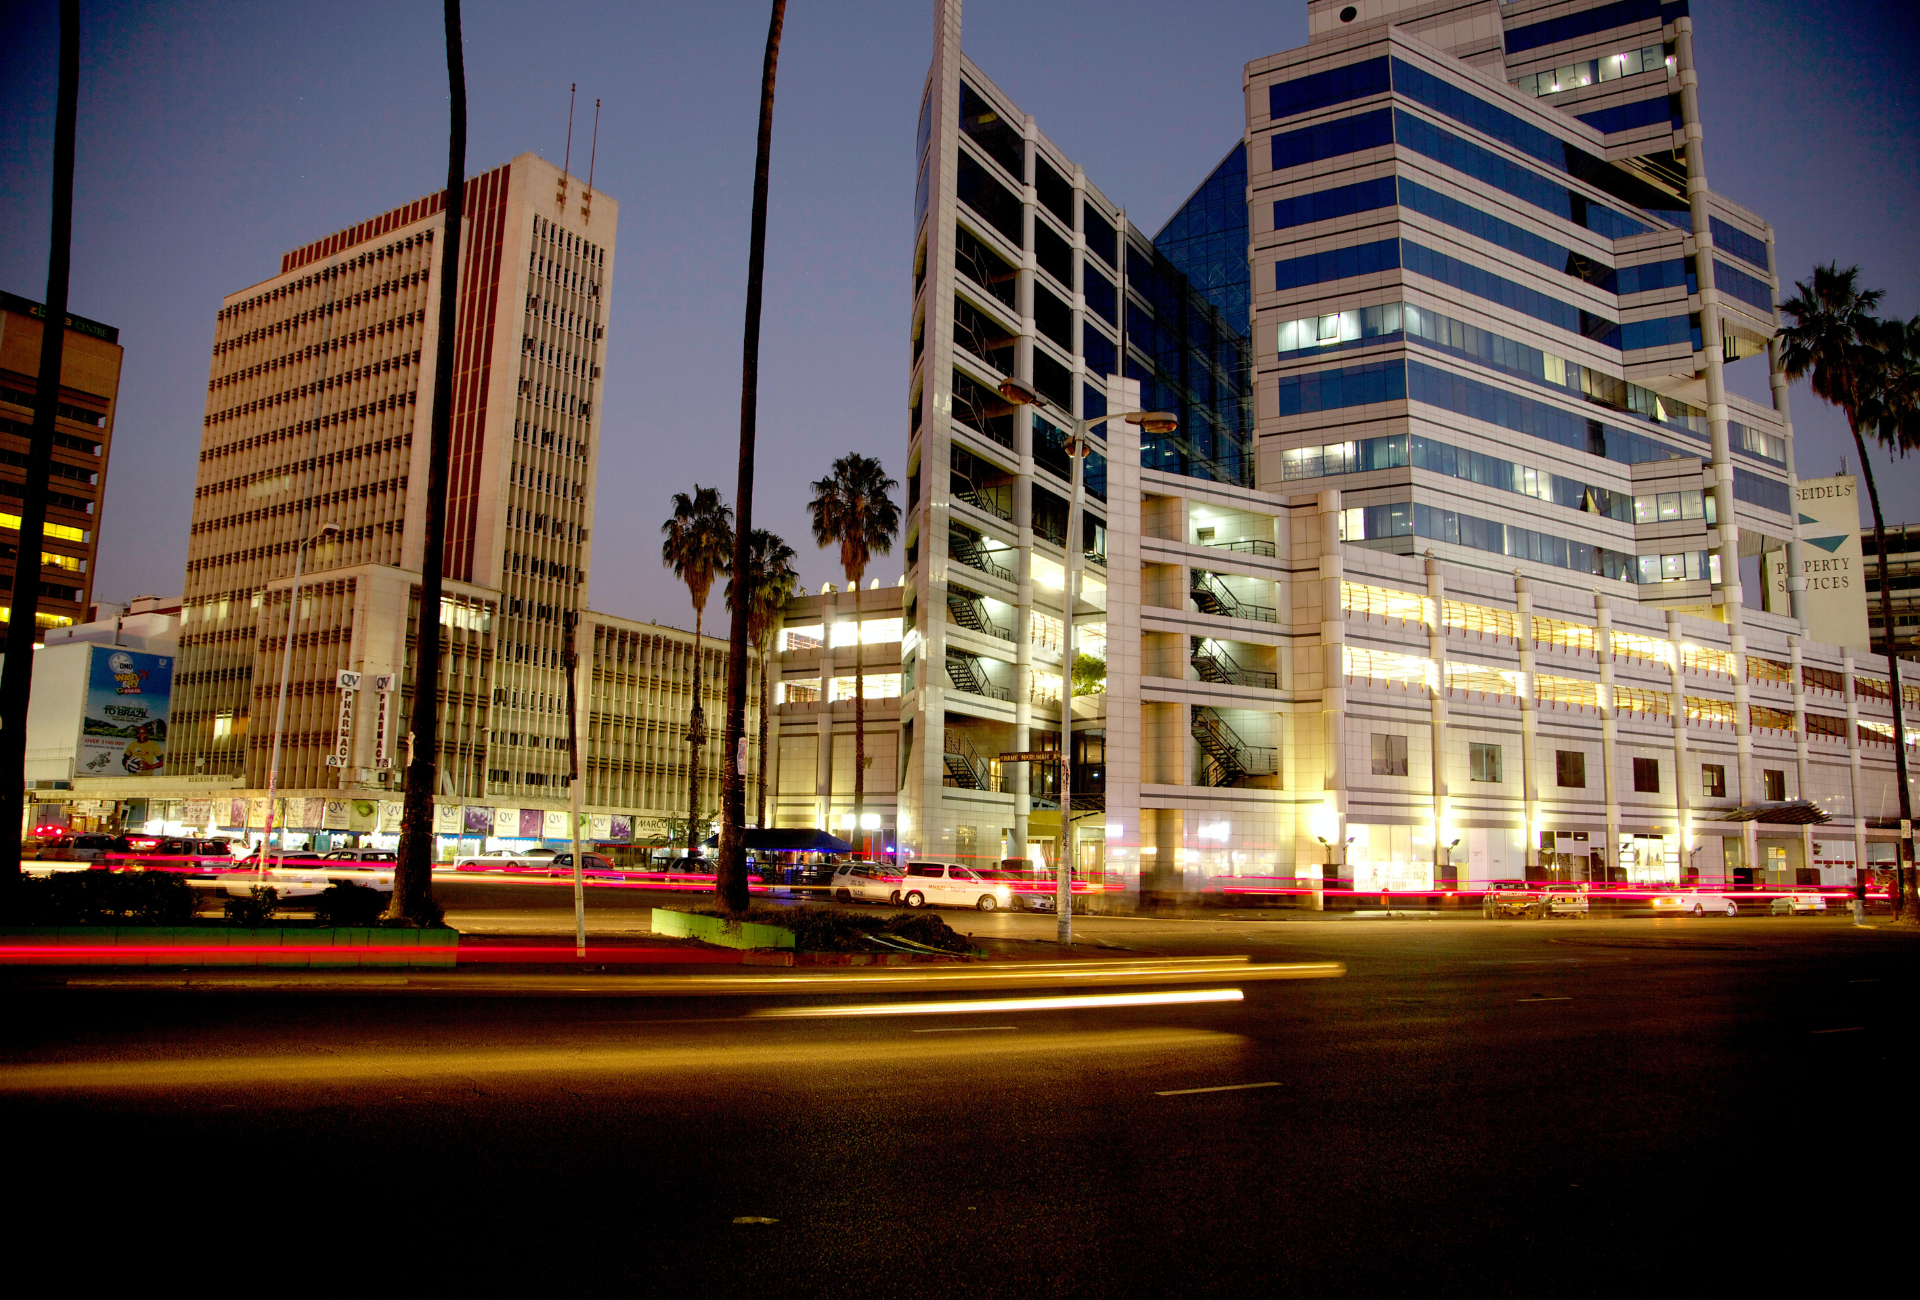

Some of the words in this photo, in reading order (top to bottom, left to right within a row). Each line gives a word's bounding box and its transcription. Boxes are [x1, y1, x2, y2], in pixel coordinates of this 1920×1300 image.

[76, 322, 108, 337] CENTRE
[1776, 558, 1850, 574] PPERTY
[1777, 576, 1850, 592] SVICES
[114, 672, 138, 682] Wash
[341, 673, 360, 687] QV
[376, 676, 390, 690] QV
[118, 708, 149, 718] BRAZIL
[339, 690, 352, 766] PHARMACY
[375, 693, 385, 767] PHARMACY
[1000, 754, 1018, 762] KWAME
[328, 802, 346, 814] QV
[386, 804, 402, 816] QV
[442, 806, 457, 818] QV
[500, 812, 513, 822] QV
[548, 814, 562, 824] QV
[594, 818, 606, 828] QV
[637, 820, 668, 828] MARCO
